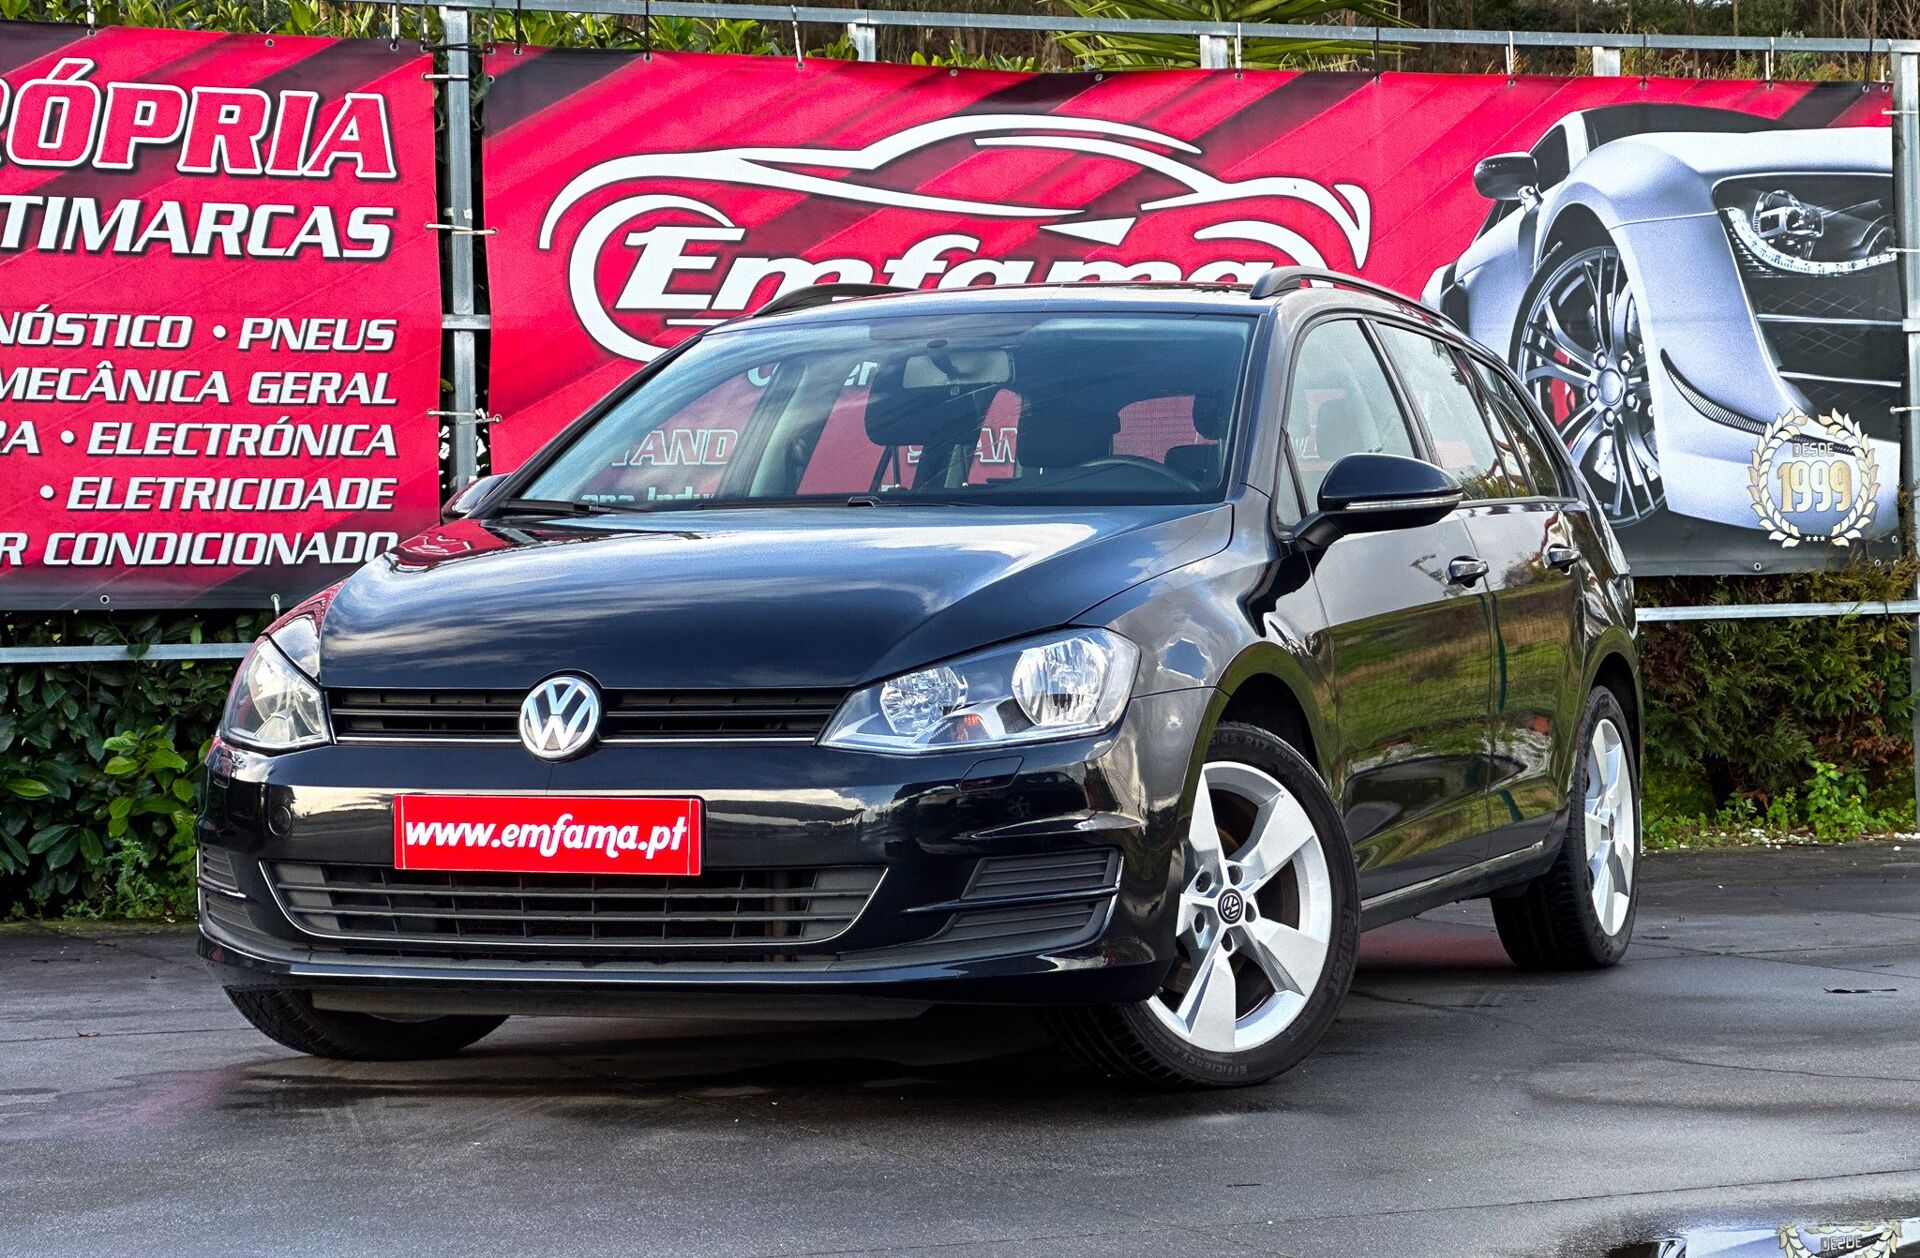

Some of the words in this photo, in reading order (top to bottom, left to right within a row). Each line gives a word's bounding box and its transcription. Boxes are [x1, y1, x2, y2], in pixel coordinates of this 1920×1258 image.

[0, 57, 397, 178] ÓPRIA
[0, 194, 394, 259] TIMARCAS
[238, 317, 397, 351] PNEUS
[0, 361, 229, 404] MECÂNICA
[248, 371, 397, 405] GERAL
[0, 420, 41, 455] A
[86, 416, 397, 457] ELECTRÓNICA
[611, 428, 738, 467] AND
[1792, 442, 1835, 457] DESDE
[66, 476, 397, 510] ELETRICIDADE
[1776, 460, 1852, 513] 1999
[43, 532, 399, 566] CONDICIONADO
[405, 813, 687, 859] www.emfama.pt
